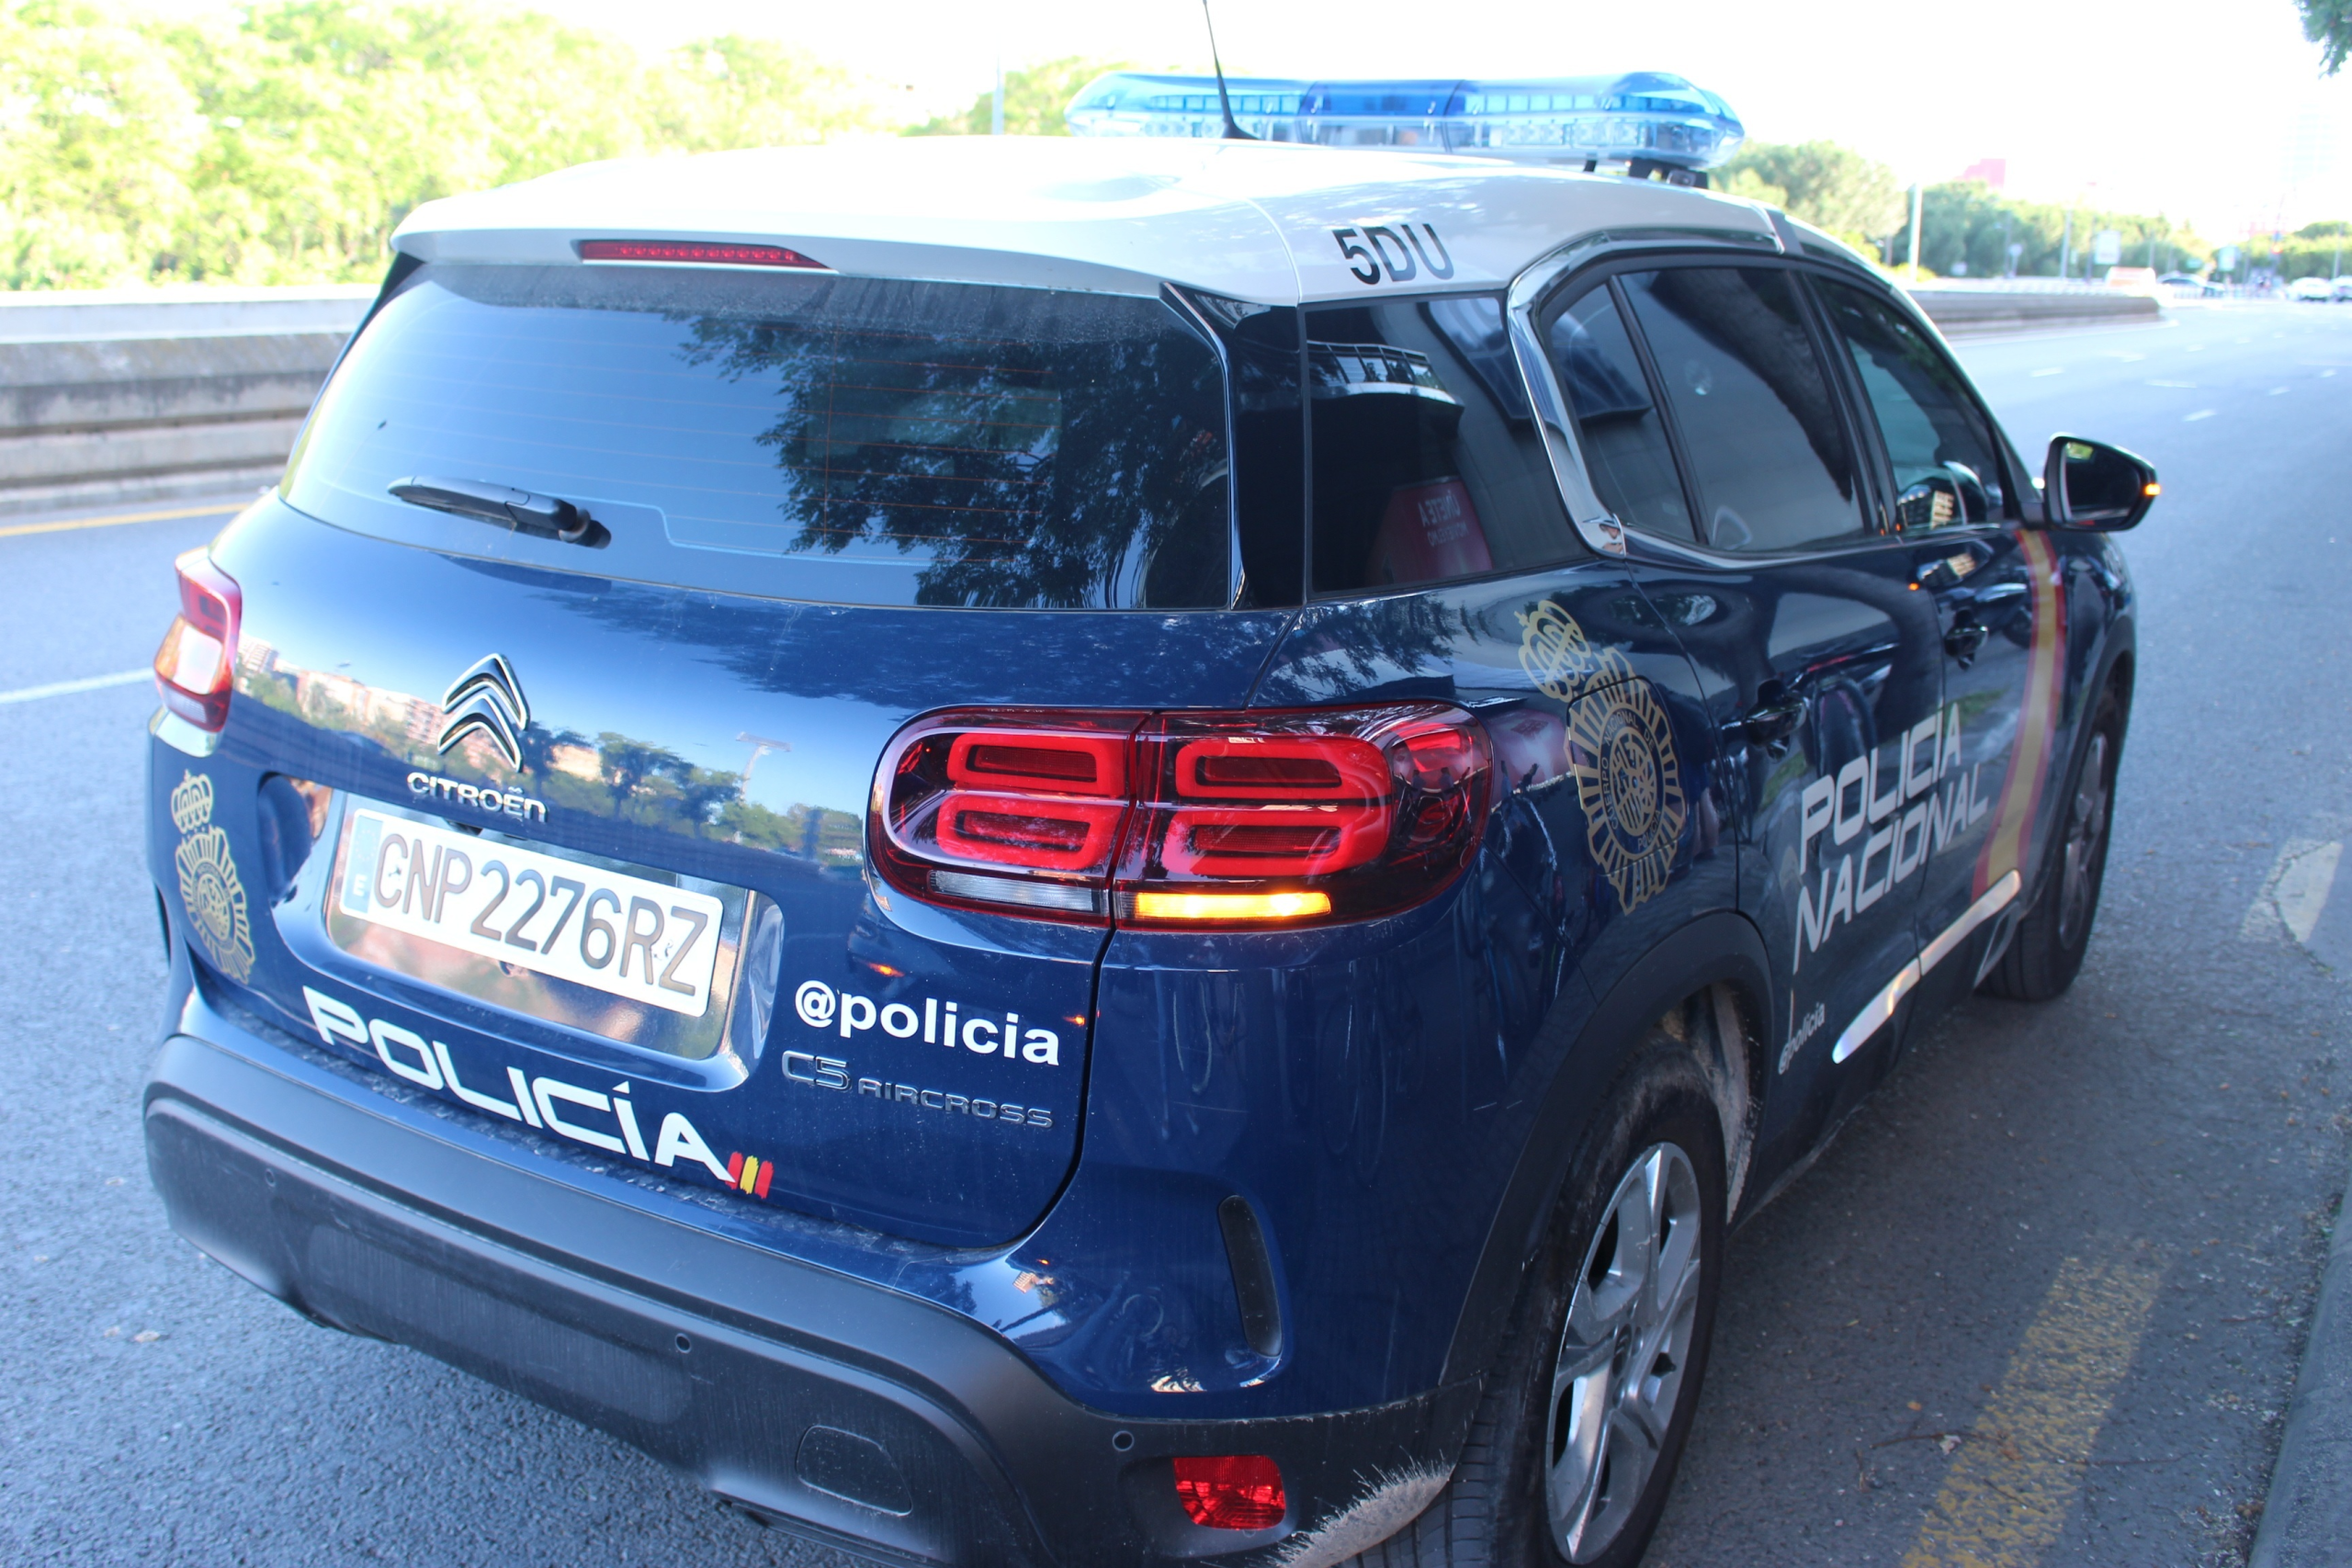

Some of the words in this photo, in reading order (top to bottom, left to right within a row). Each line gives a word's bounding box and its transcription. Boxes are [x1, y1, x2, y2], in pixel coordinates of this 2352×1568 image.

[1332, 223, 1454, 286] 5DU
[1604, 710, 1639, 746] NACIONAL
[1644, 728, 1655, 751] DE
[407, 772, 547, 823] CITROËN
[1601, 757, 1619, 829] CUERPO
[353, 874, 367, 897] E
[1792, 762, 1988, 975] NACIONAL
[796, 980, 1058, 1066] @policia
[302, 985, 736, 1183] POLICÍA
[782, 1050, 851, 1090] C5
[858, 1077, 1054, 1129] AIRCROSS
